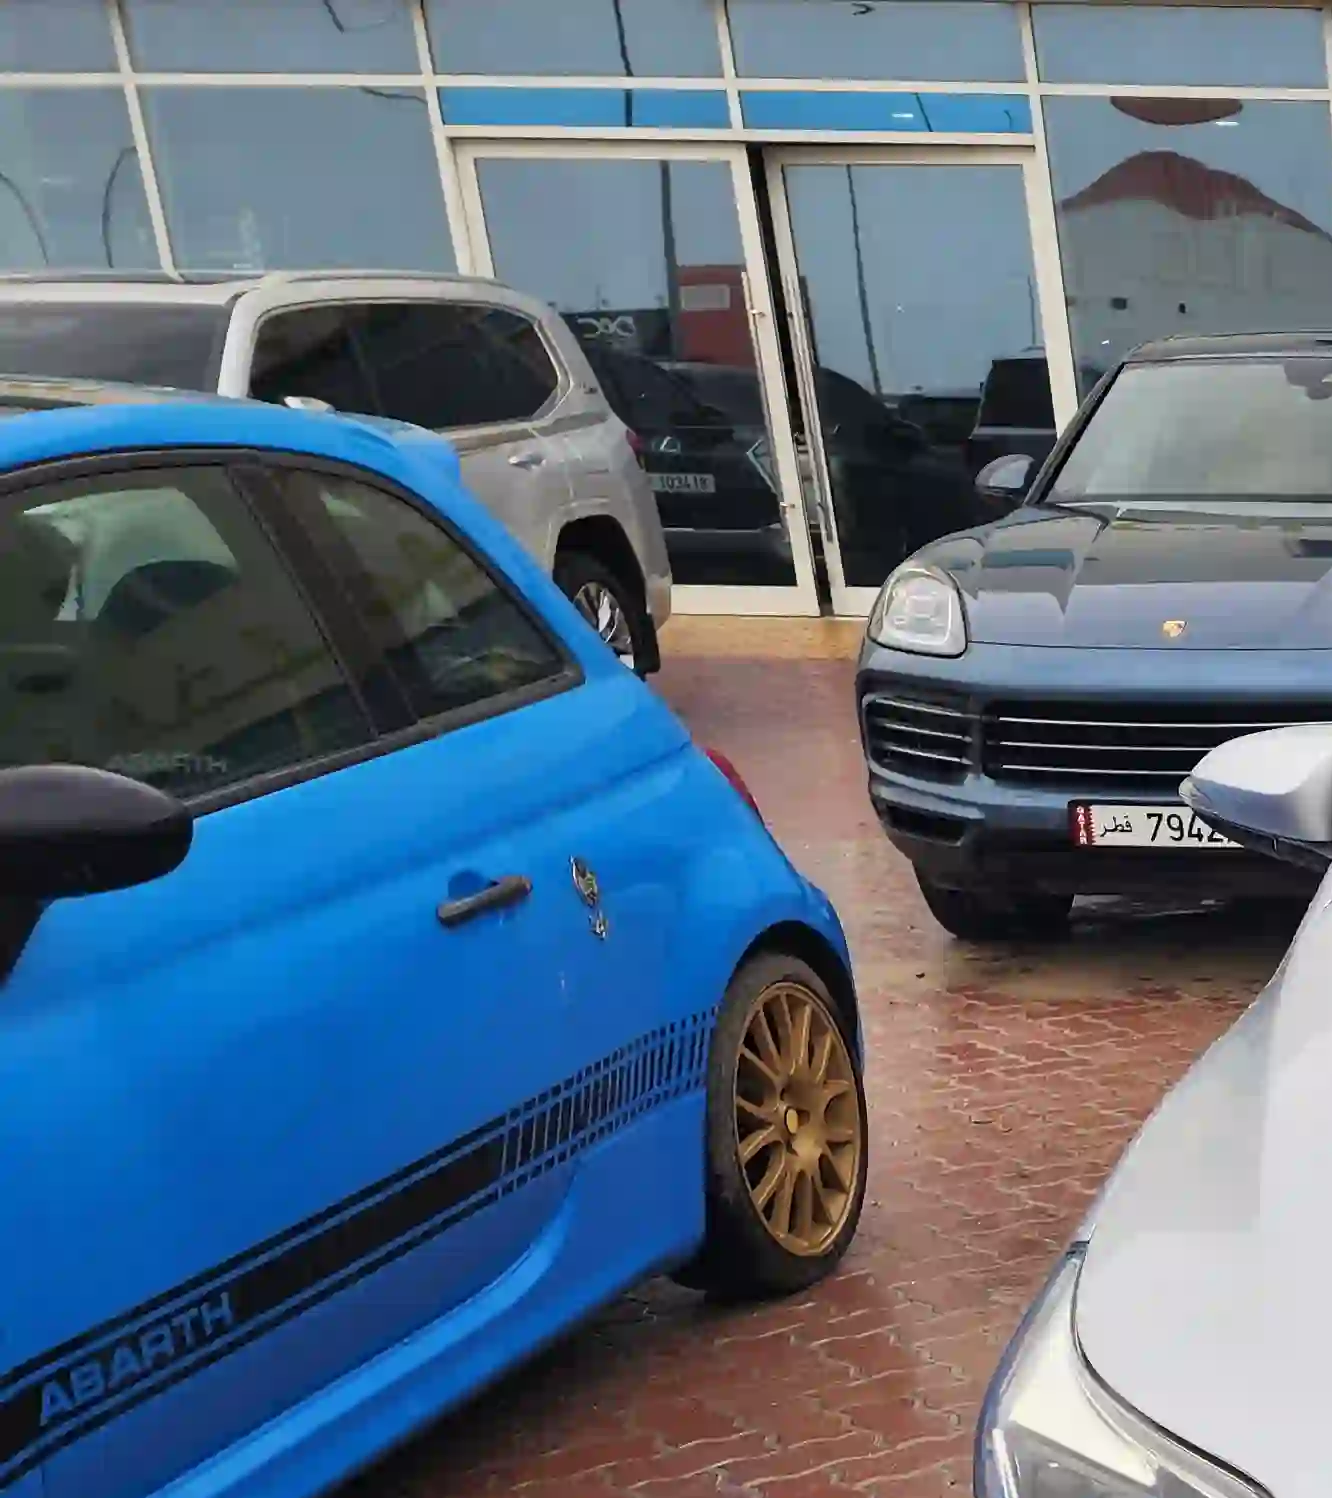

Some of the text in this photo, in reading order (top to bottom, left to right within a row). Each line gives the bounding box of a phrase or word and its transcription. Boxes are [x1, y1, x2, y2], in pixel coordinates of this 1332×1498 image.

[1076, 805, 1088, 845] QATAR
[1100, 812, 1232, 843] قطر 794
[40, 1292, 233, 1427] ABARTH
